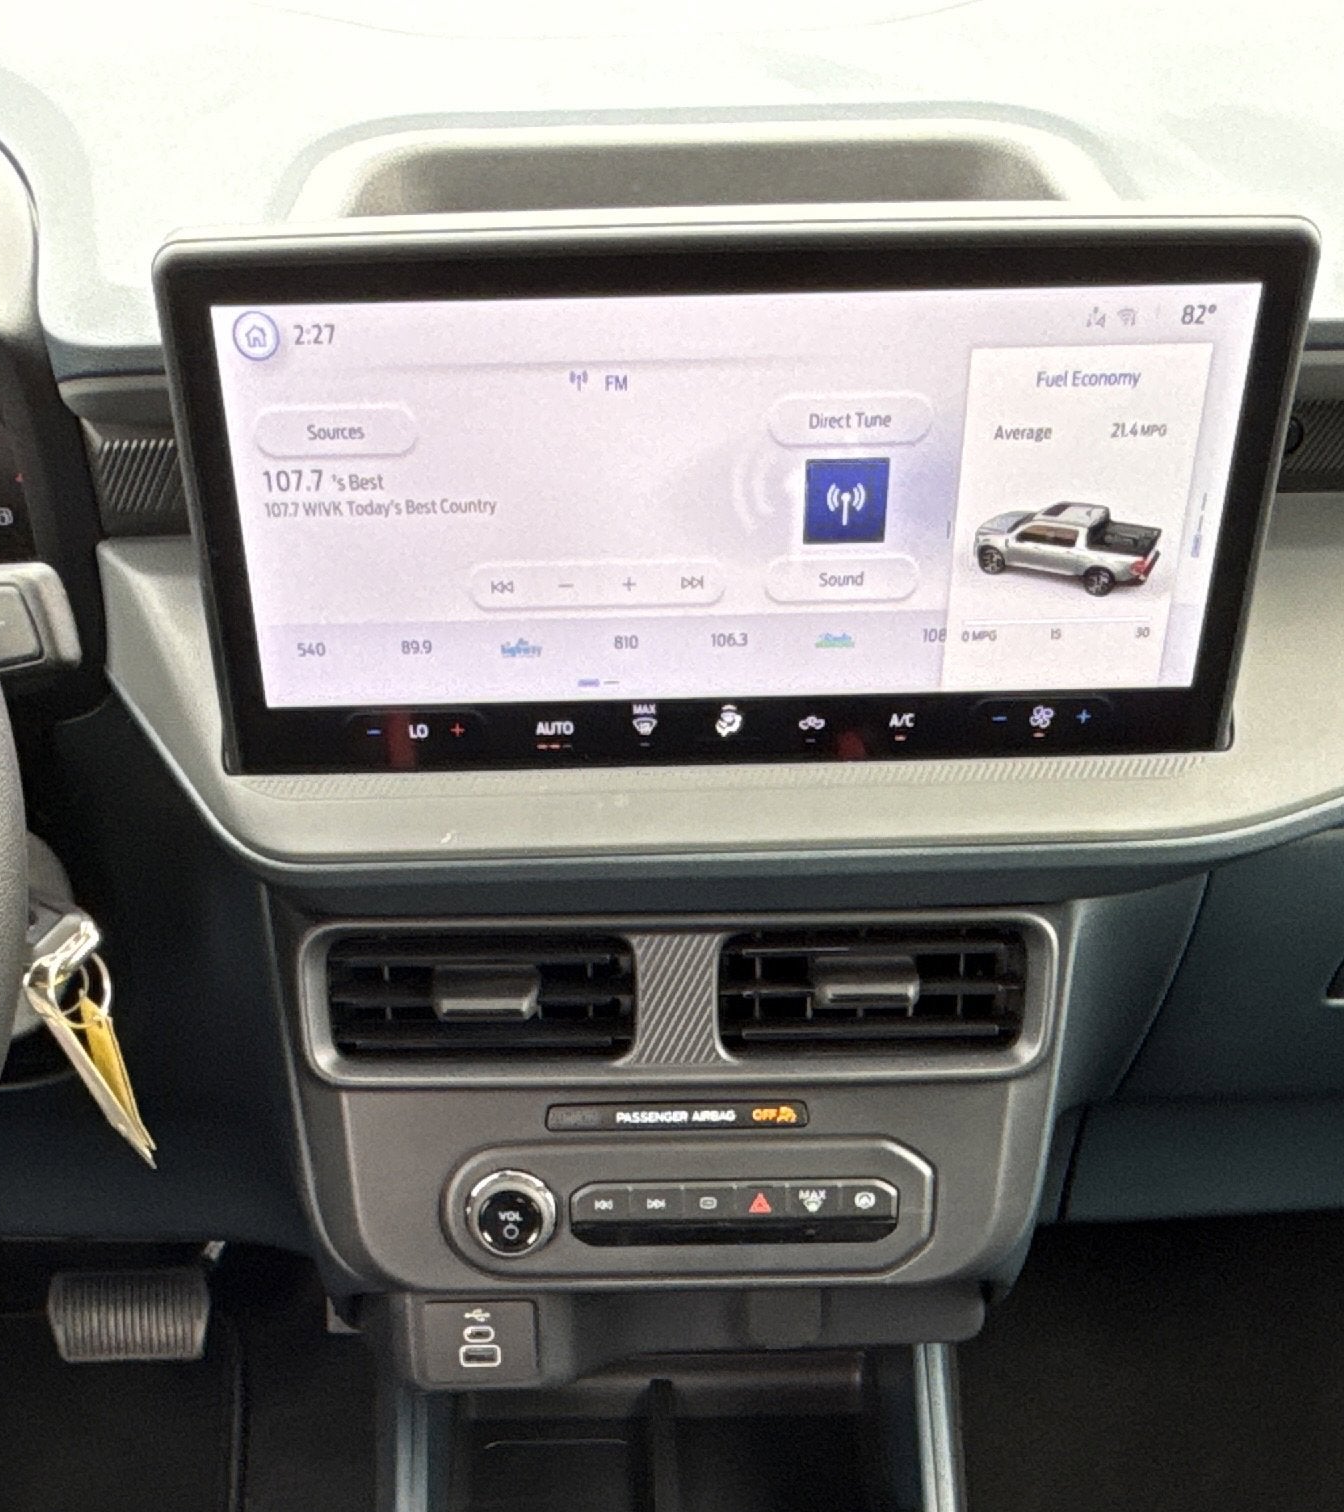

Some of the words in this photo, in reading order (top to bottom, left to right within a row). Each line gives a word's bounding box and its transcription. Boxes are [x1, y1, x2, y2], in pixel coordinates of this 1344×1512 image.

[293, 324, 336, 345] 2:27
[605, 375, 628, 391] FM
[1036, 370, 1068, 388] Fuel
[1072, 370, 1141, 389] Economy
[808, 412, 853, 430] Direct
[857, 411, 892, 429] Tune
[307, 424, 365, 442] Sources
[994, 425, 1052, 442] Average
[1140, 424, 1167, 437] MPG
[263, 469, 323, 492] 107.7
[349, 474, 385, 491] Best
[264, 502, 298, 518] 107.7
[303, 501, 343, 517] WIVK
[346, 500, 402, 518] Today's
[406, 500, 437, 516] Best
[440, 498, 497, 516] Country
[819, 571, 864, 588] Sound
[972, 630, 997, 642] MPG
[1135, 627, 1150, 638] 30
[297, 642, 326, 657] 540
[401, 639, 432, 655] 89.9
[614, 635, 639, 649] 810
[711, 632, 748, 648] 106.3
[633, 704, 656, 715] MAX
[409, 723, 429, 739] LO
[536, 721, 575, 736] AUTO
[889, 713, 915, 729] A/C
[616, 1110, 689, 1123] PASSENGER
[692, 1110, 736, 1122] AIRBAG
[752, 1108, 777, 1121] OFF
[798, 1189, 826, 1201] MAX
[498, 1211, 523, 1221] VOL
